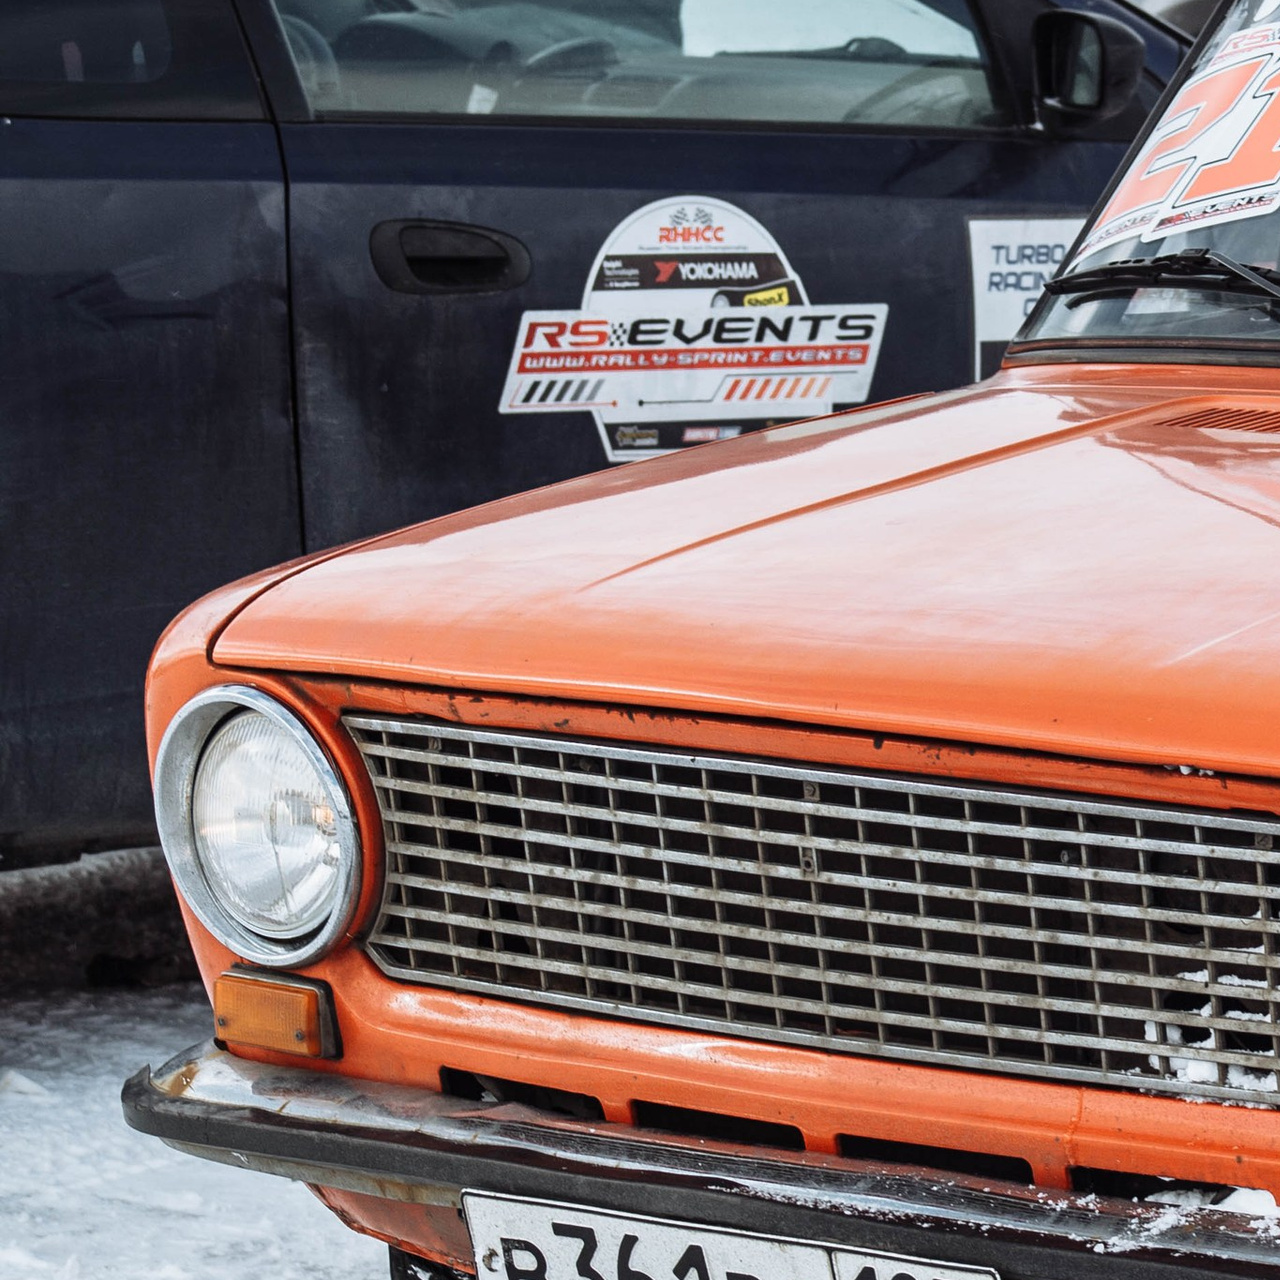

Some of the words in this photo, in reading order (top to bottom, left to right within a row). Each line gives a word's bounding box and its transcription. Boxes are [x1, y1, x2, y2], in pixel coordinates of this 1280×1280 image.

[991, 244, 1066, 265] TURBO
[678, 261, 759, 281] YOKOHAMA
[988, 271, 1054, 292] RACIN
[523, 320, 609, 349] RS
[627, 314, 876, 346] EVENTS
